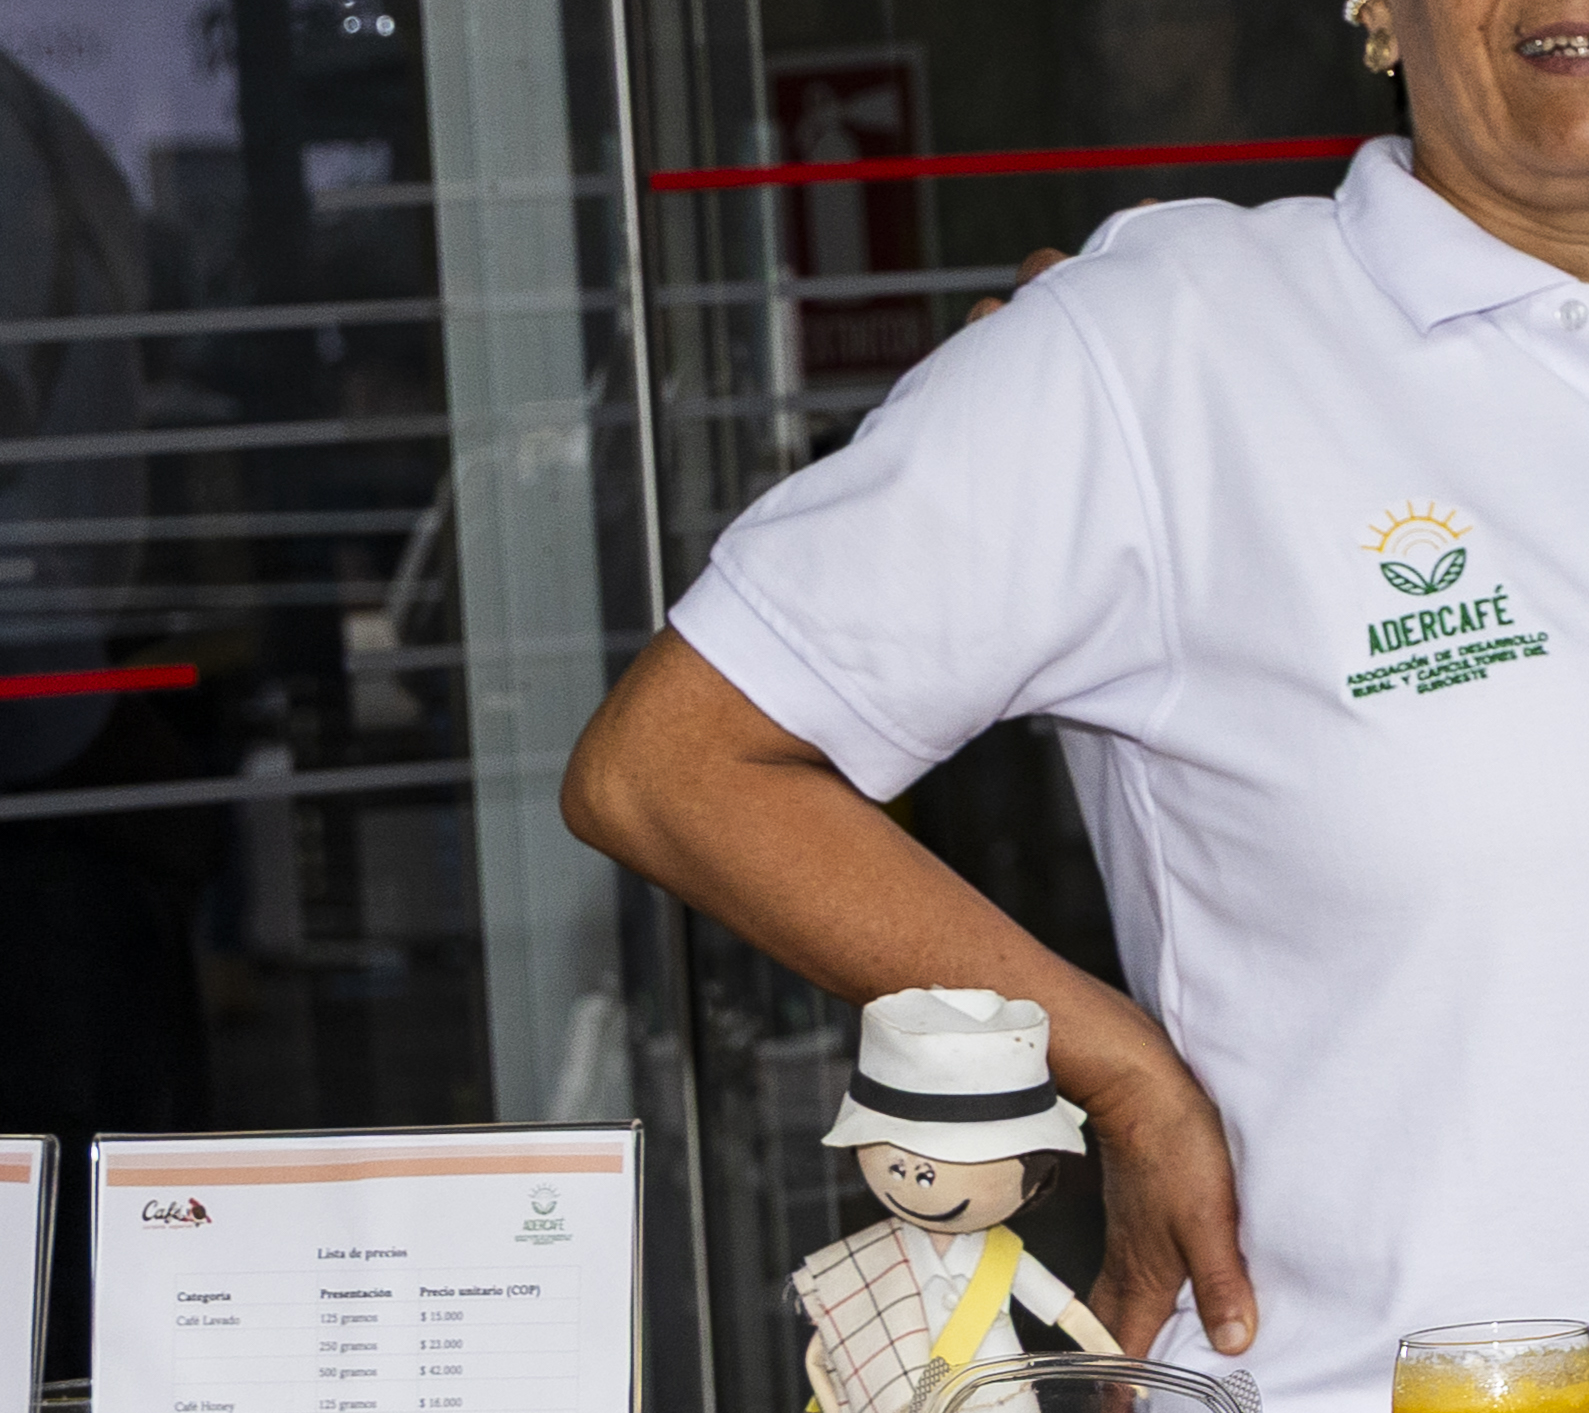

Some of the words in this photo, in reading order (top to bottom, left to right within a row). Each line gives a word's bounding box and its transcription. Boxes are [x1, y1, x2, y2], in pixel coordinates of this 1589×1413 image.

[1367, 584, 1515, 656] ADERCAFÉ
[1434, 649, 1453, 663] DE
[1458, 631, 1549, 656] DESARROLLO
[1401, 673, 1411, 685] Y
[317, 1248, 345, 1260] Lista
[349, 1247, 362, 1259] de
[365, 1246, 408, 1262] precios
[419, 1286, 455, 1297] Precio
[458, 1285, 503, 1297] unitario
[506, 1284, 541, 1298] (COP)
[176, 1315, 200, 1326] Café
[202, 1316, 241, 1326] Lavado
[174, 1401, 198, 1412] Café
[200, 1401, 234, 1413] Honey
